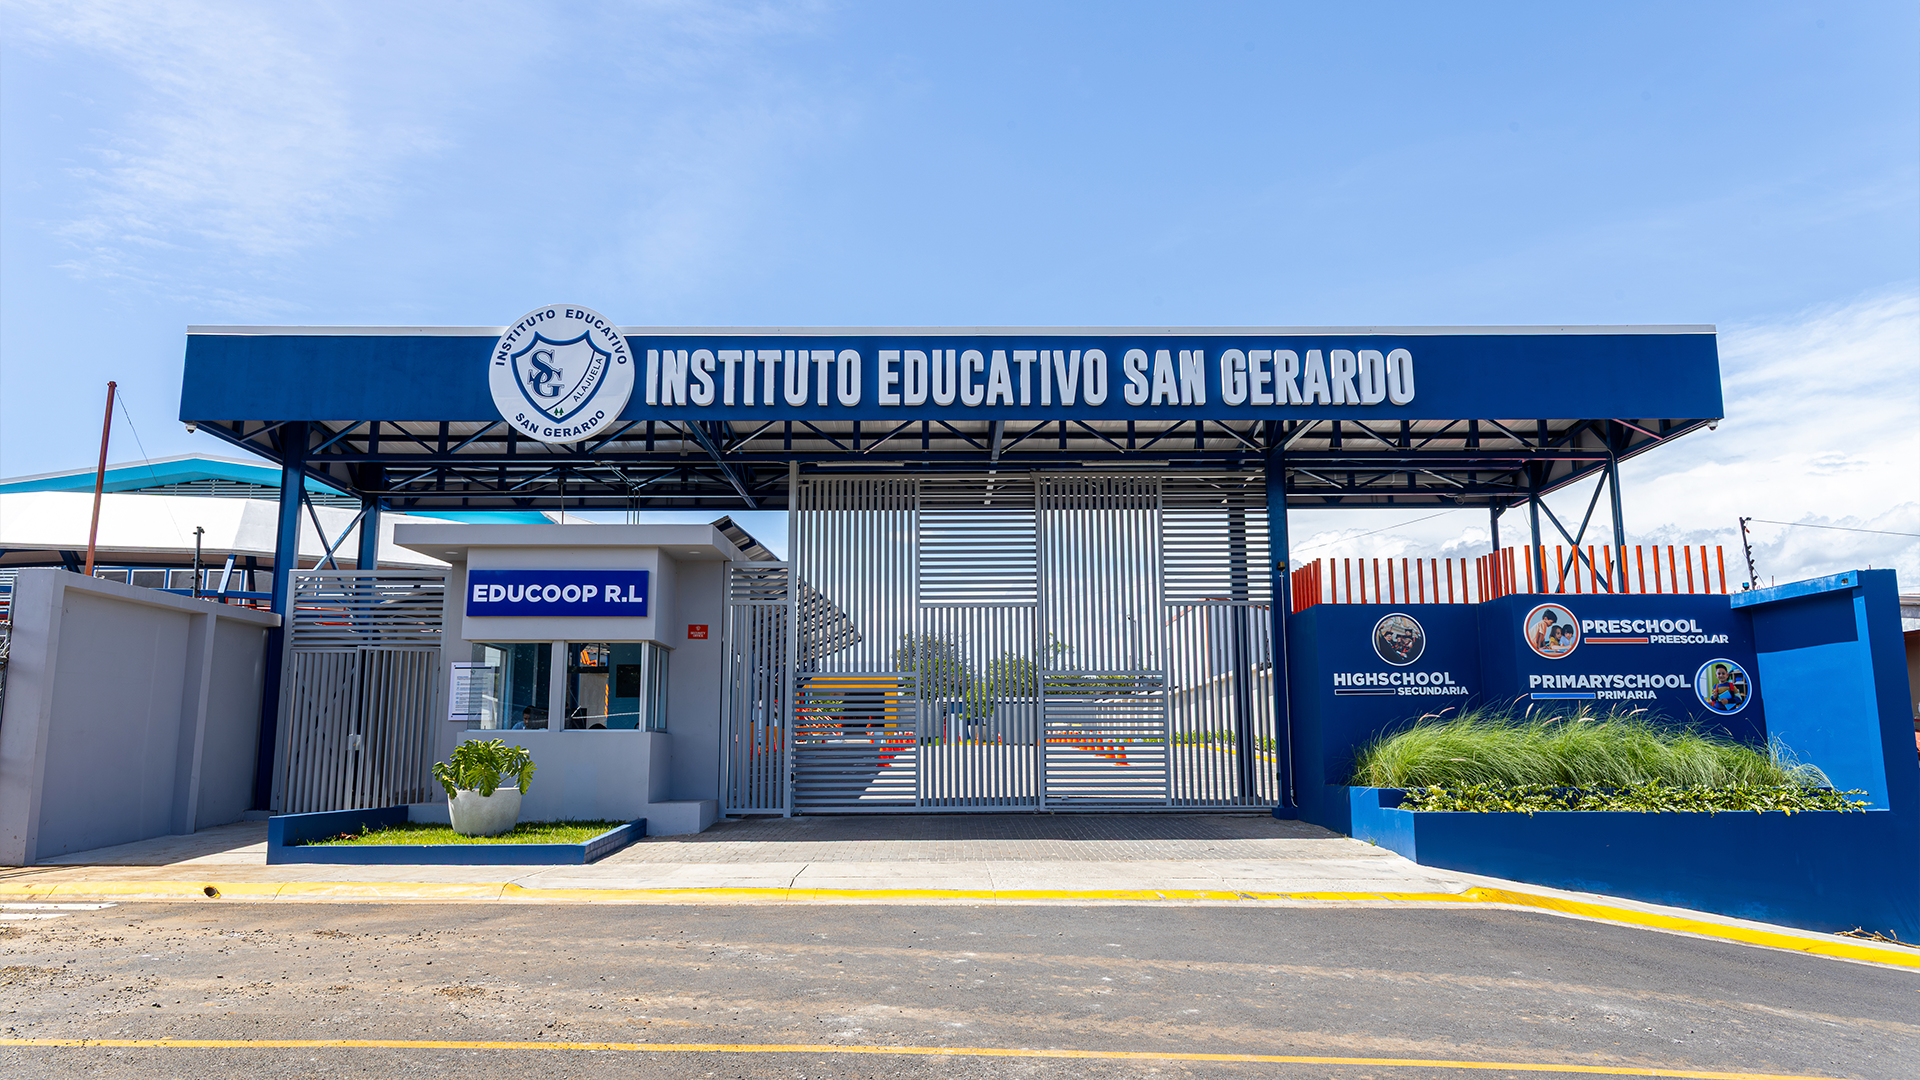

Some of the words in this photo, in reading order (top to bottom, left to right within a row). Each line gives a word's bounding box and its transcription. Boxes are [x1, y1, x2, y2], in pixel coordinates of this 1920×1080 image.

[495, 309, 556, 367] INSTITUTO
[565, 308, 627, 365] EDUCATIVO
[573, 357, 603, 402] ALAJUELA
[646, 349, 862, 406] INSTITUTO
[878, 349, 1108, 406] EDUCATIVO
[1123, 349, 1206, 406] SAN
[1220, 348, 1415, 406] GERARDO
[515, 412, 539, 434] SAN
[543, 410, 605, 437] GERARDO
[472, 584, 598, 603] EDUCOOP
[604, 584, 643, 603] R.L
[1582, 619, 1703, 634] PRESCHOOL
[1650, 634, 1729, 644] PREESCOLAR
[1333, 672, 1456, 686] HIGHSCHOOL
[1529, 674, 1692, 689] PRIMARYSCHOOL
[1397, 686, 1469, 696] SECUNDARIA
[1597, 690, 1657, 700] PRIMARIA
